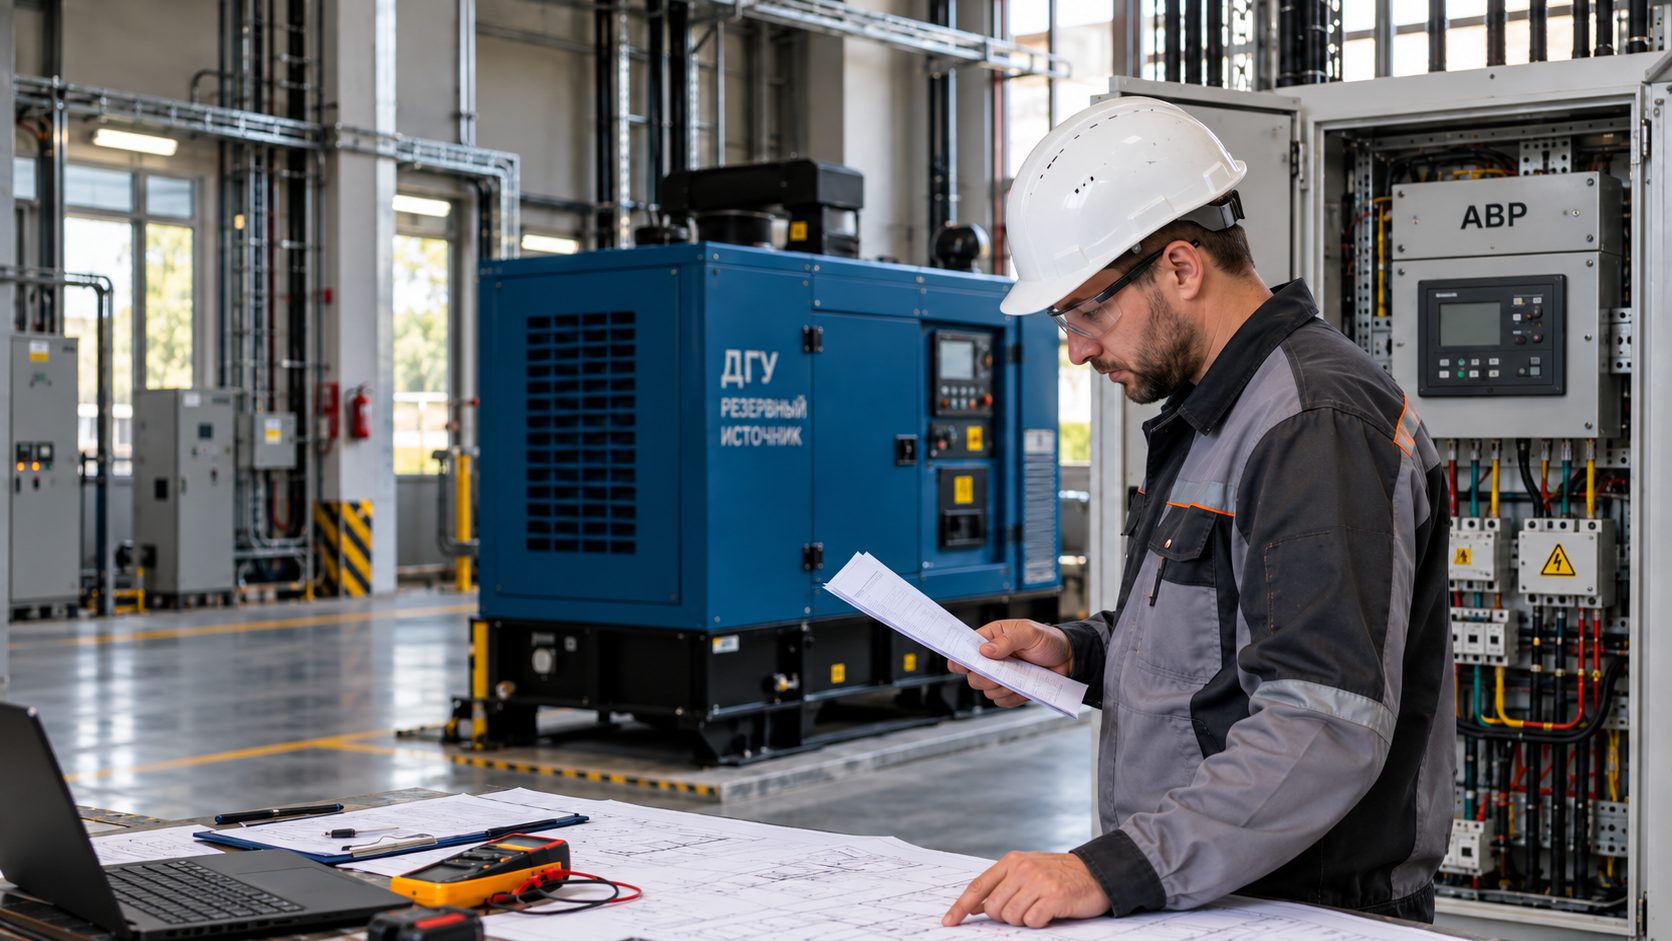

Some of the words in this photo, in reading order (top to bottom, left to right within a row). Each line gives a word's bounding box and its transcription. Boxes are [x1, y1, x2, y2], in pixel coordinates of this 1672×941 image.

[1460, 202, 1528, 230] АВР
[721, 349, 779, 389] ДГУ
[721, 394, 808, 419] РЕЗЕРВНЫЙ
[721, 425, 803, 447] ИСТОЧНИК
